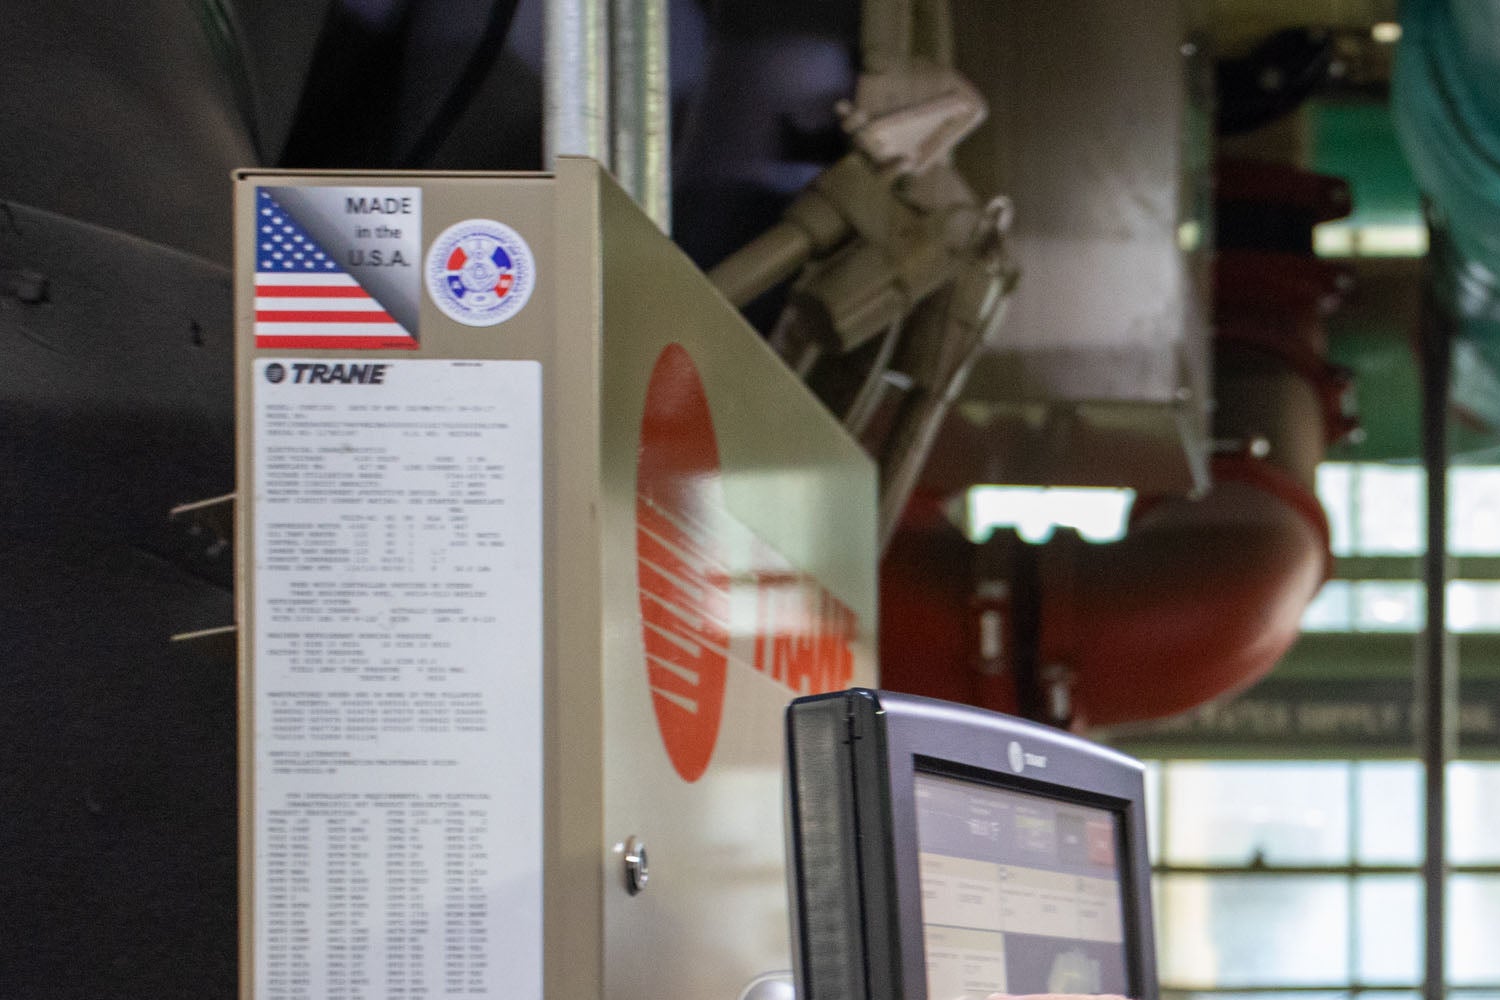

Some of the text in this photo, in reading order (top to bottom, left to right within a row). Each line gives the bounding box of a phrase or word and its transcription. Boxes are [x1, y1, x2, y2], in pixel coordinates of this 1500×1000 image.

[346, 197, 412, 215] MADE
[355, 224, 402, 239] in the
[348, 249, 411, 267] U.S.A.
[291, 363, 387, 385] TRANE
